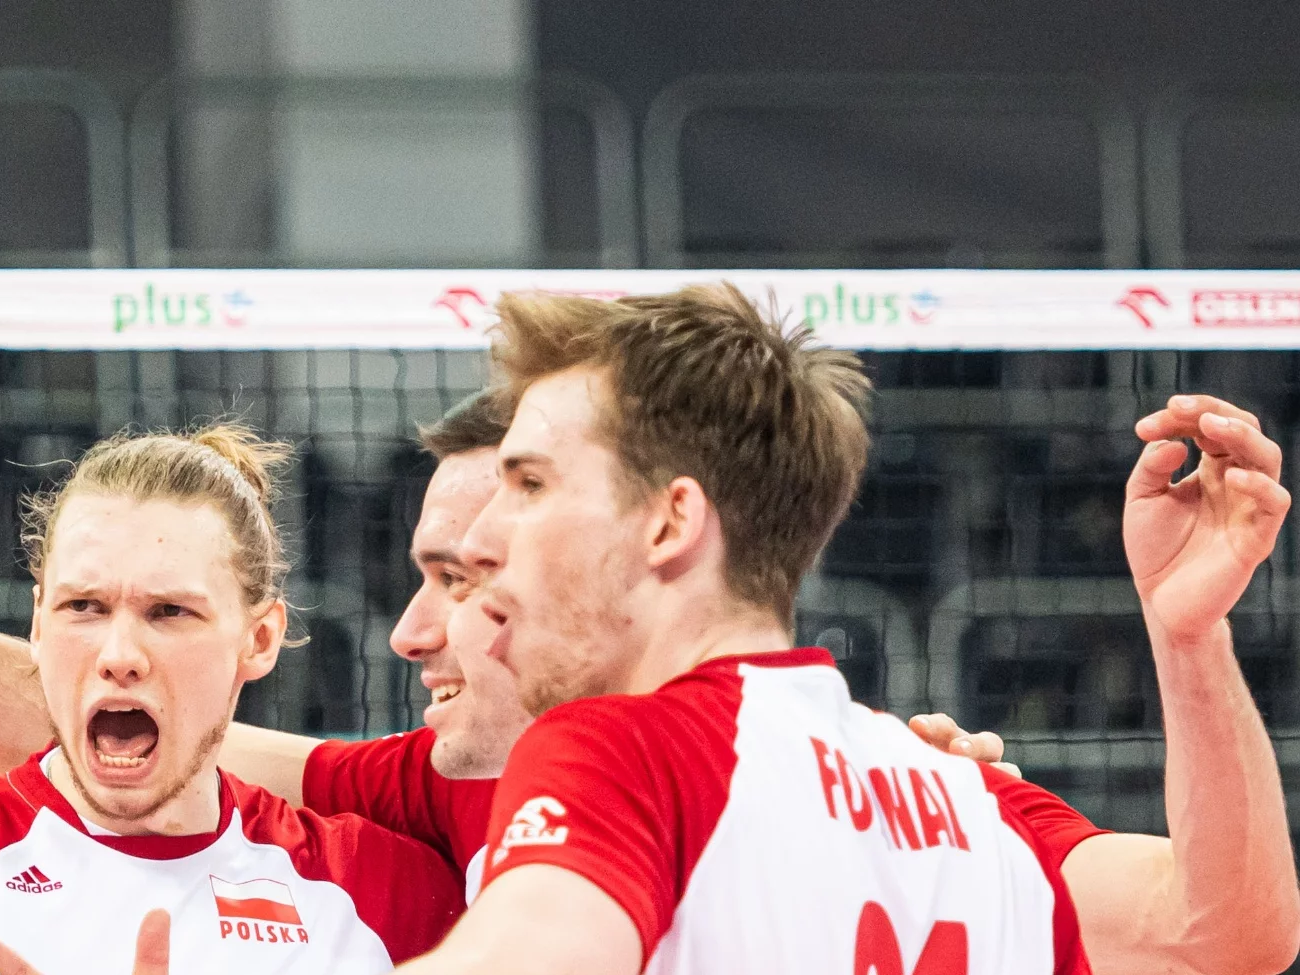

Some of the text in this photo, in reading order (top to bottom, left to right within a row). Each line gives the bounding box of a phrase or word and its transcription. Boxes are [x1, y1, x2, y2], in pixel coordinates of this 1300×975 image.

[112, 281, 212, 333] plus
[805, 281, 899, 329] plus
[5, 880, 63, 894] adidas
[220, 920, 309, 944] POLSKA
